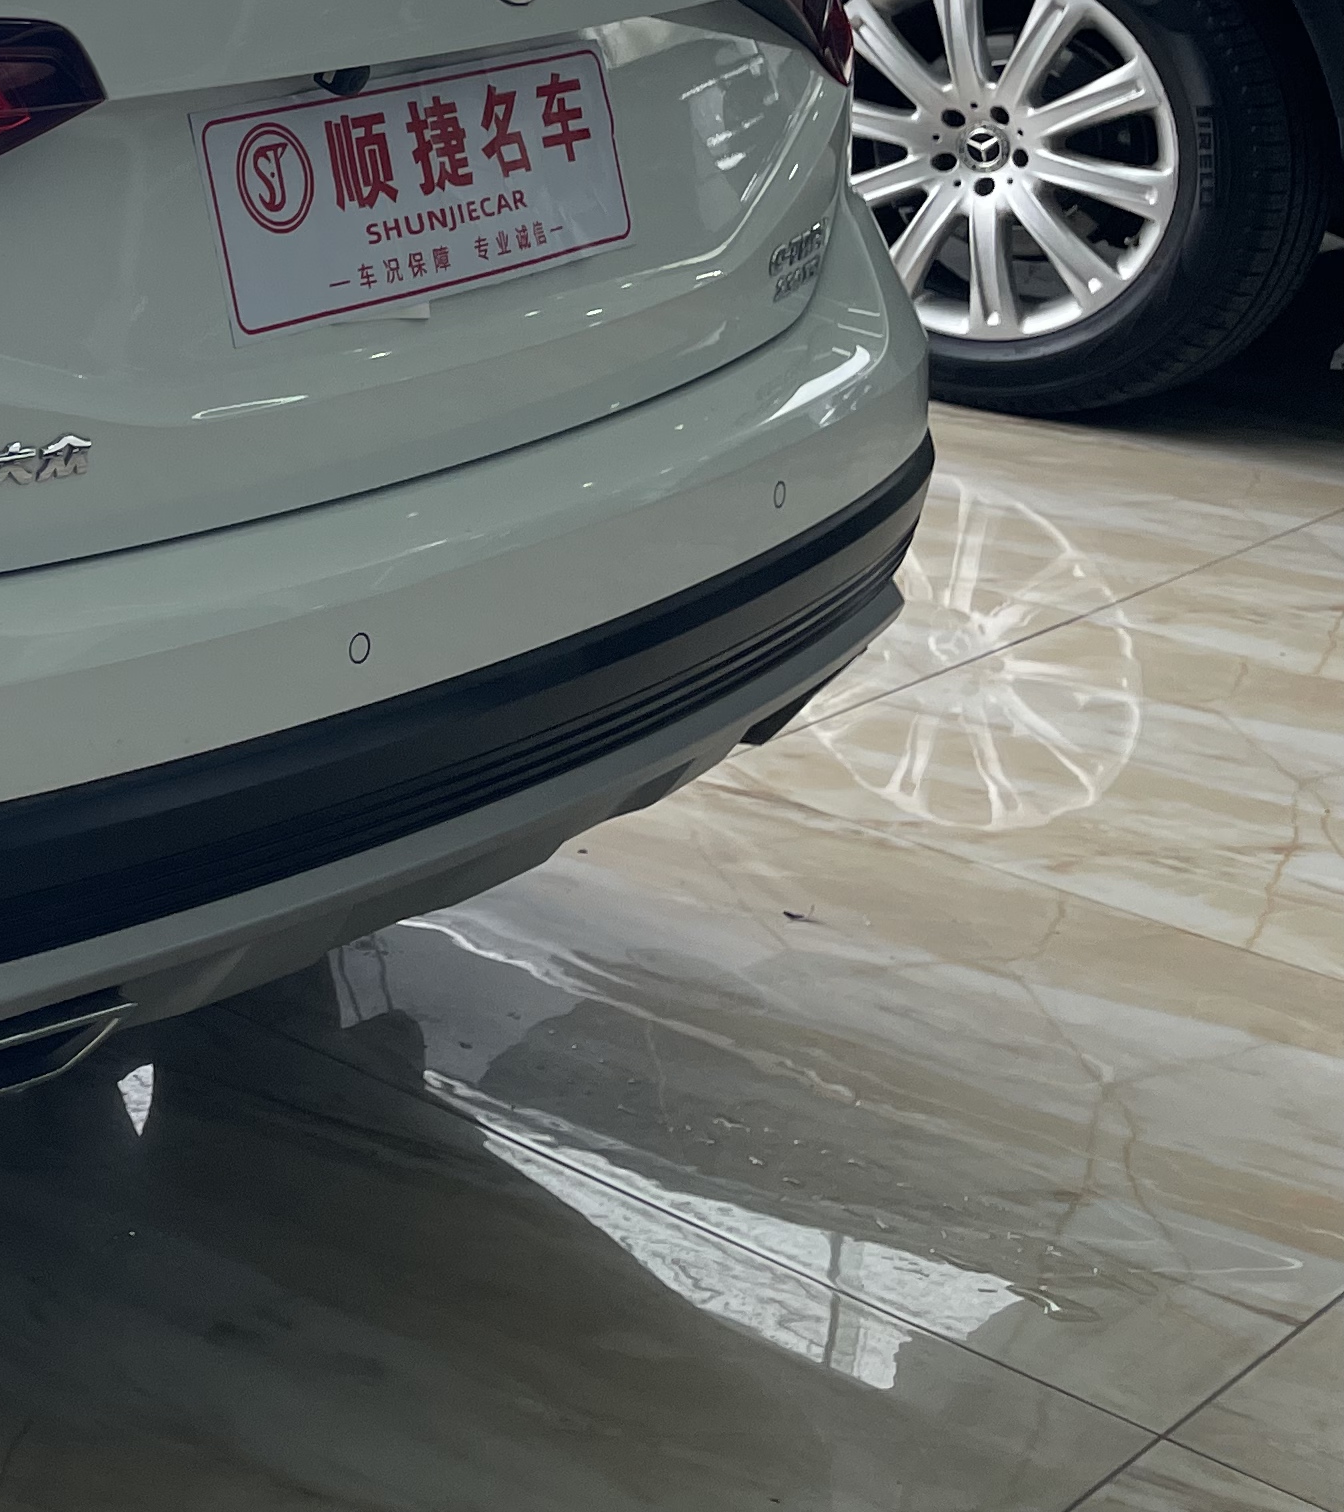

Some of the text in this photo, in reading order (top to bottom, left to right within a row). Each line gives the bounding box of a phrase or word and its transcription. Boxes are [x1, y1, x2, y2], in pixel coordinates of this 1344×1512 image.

[324, 72, 592, 212] 顺捷名车
[365, 189, 528, 245] SHUNJIECAR
